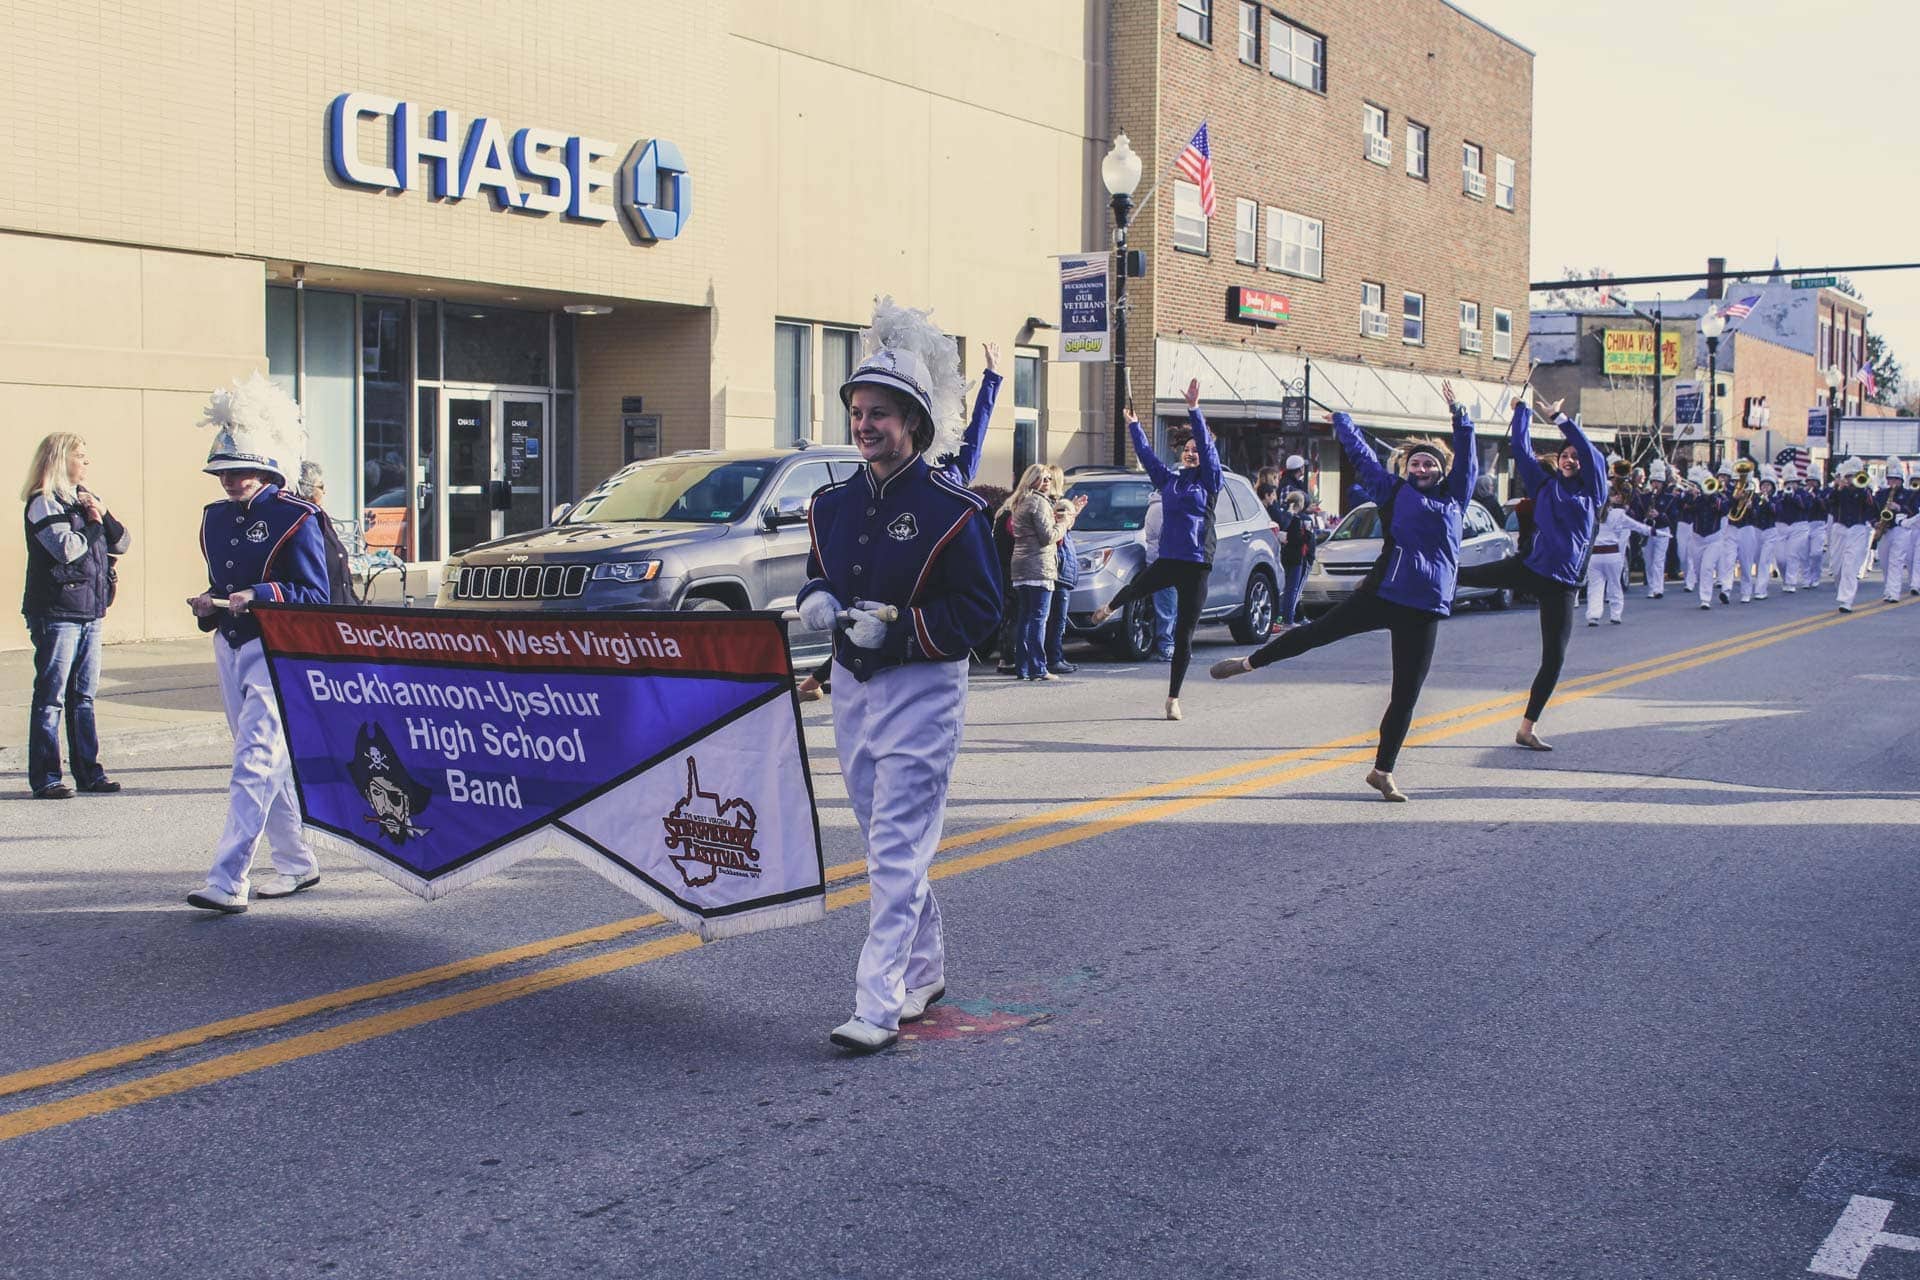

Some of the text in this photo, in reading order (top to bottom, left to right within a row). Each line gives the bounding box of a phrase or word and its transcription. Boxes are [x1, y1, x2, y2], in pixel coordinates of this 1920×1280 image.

[329, 92, 619, 223] CHASE
[1072, 315, 1098, 323] U.S.A.
[1606, 333, 1634, 351] CHINA
[457, 418, 475, 426] CHASE
[507, 554, 528, 563] Jeep
[336, 621, 682, 664] Buckhannon, West Virginia
[306, 669, 601, 722] Buckhannon-Upshur
[405, 717, 586, 763] High School
[446, 769, 522, 809] Band
[681, 839, 752, 869] FESTIVAL
